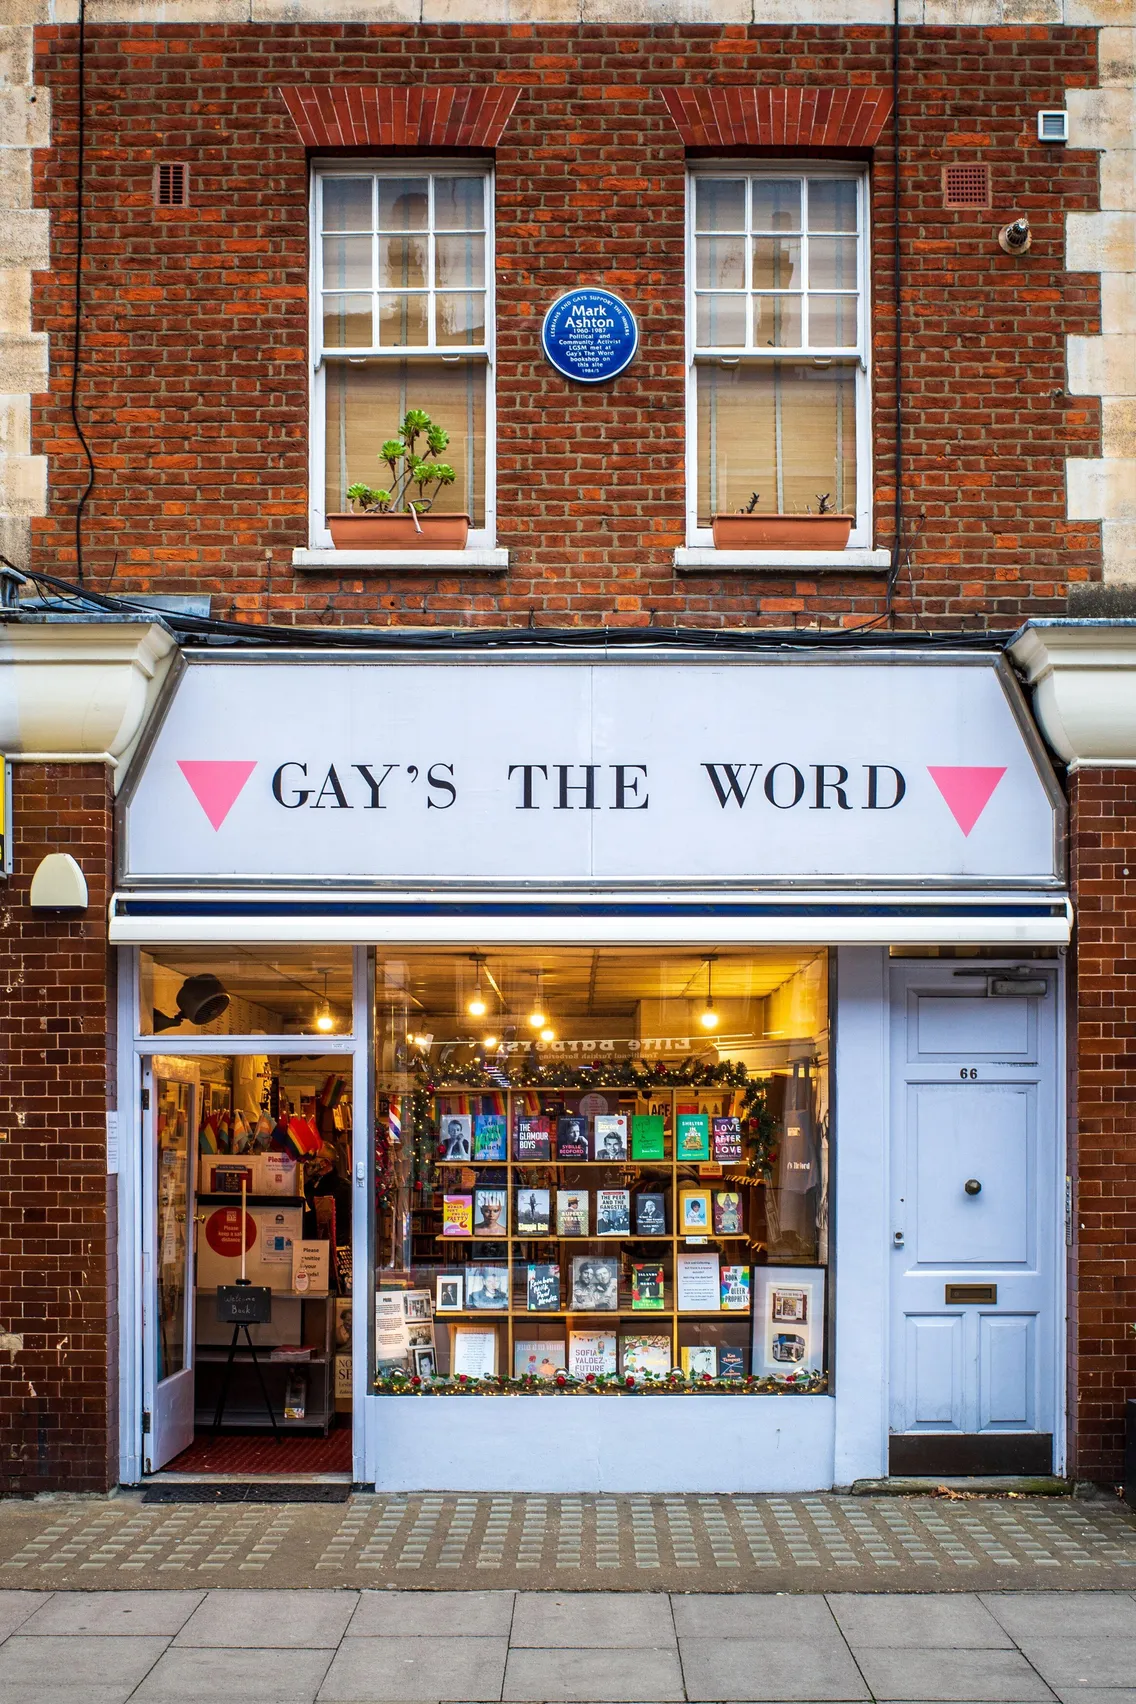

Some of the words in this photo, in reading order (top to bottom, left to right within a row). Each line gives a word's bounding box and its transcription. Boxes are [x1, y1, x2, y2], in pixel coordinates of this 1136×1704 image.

[572, 305, 607, 316] Mark
[550, 312, 561, 338] LESBIANS
[560, 300, 572, 311] AND
[590, 295, 614, 306] SUPPORT
[614, 306, 623, 316] THE
[621, 316, 630, 336] MINERS
[564, 317, 614, 328] Ashton
[272, 762, 458, 810] GAY'S
[508, 763, 650, 810] THE
[700, 762, 907, 810] WORD
[960, 1068, 978, 1080] 66
[520, 1132, 548, 1140] GLAMOUR
[715, 1135, 741, 1143] AFTER
[520, 1141, 536, 1149] BOYS
[478, 1191, 505, 1206] SKIN
[530, 1276, 554, 1290] Rainbow
[224, 1294, 255, 1302] Welcome
[538, 1294, 558, 1306] Mendez
